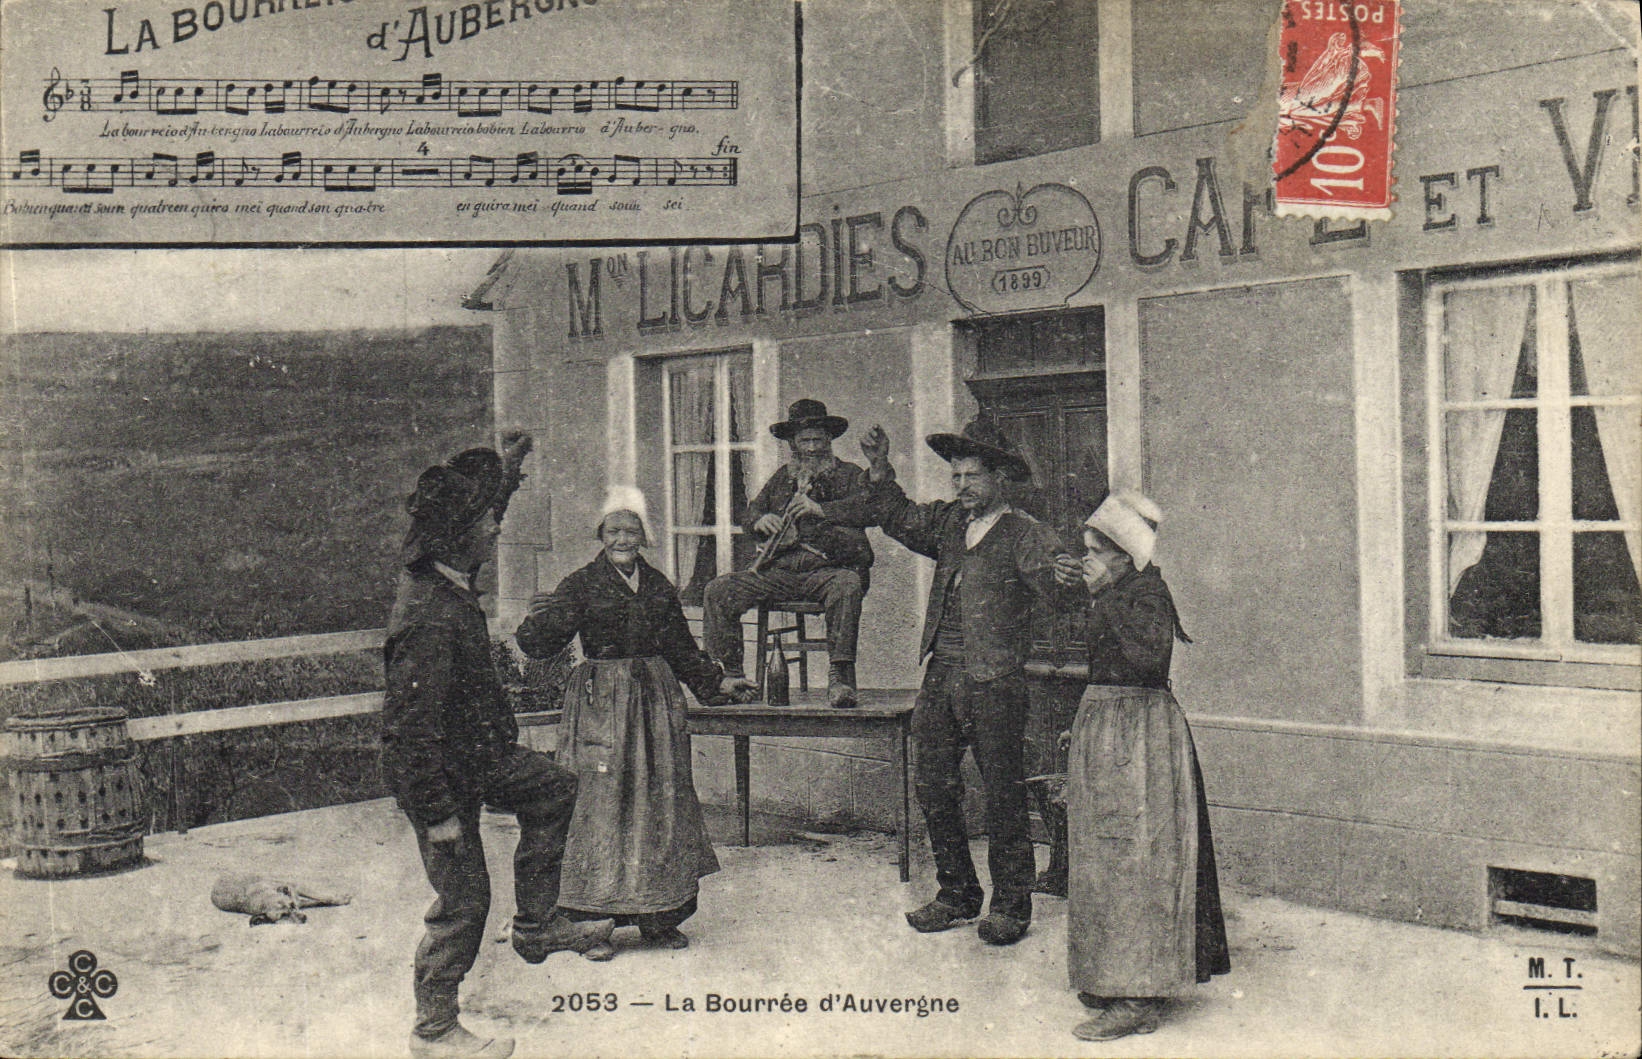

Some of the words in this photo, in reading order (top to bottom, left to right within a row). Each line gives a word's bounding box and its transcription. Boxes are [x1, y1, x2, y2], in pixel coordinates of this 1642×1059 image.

[1302, 1, 1385, 23] POSTES
[1418, 164, 1501, 232] ET
[953, 241, 979, 266] AU
[981, 234, 1021, 263] BON
[1026, 224, 1098, 257] BUVEUR
[998, 270, 1042, 292] 1899
